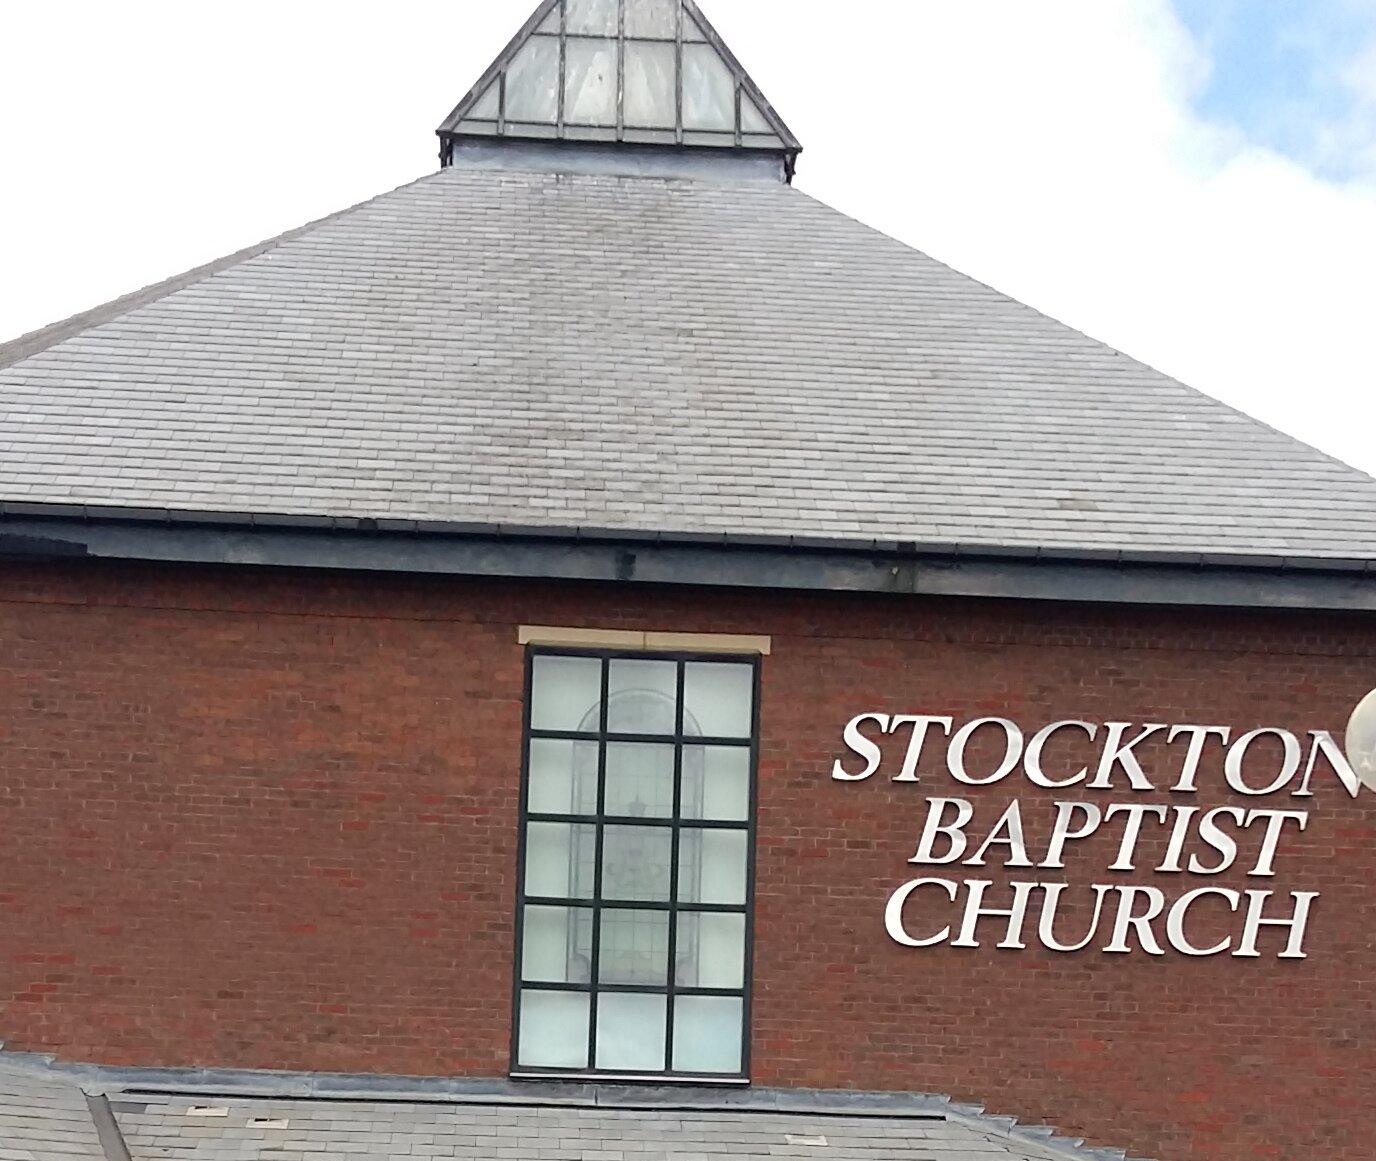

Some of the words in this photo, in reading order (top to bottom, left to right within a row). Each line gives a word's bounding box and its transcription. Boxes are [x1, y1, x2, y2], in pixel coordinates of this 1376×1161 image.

[831, 713, 1362, 799] STOCKTON
[908, 797, 1308, 876] BAPTIST
[884, 877, 1321, 959] CHURCH
